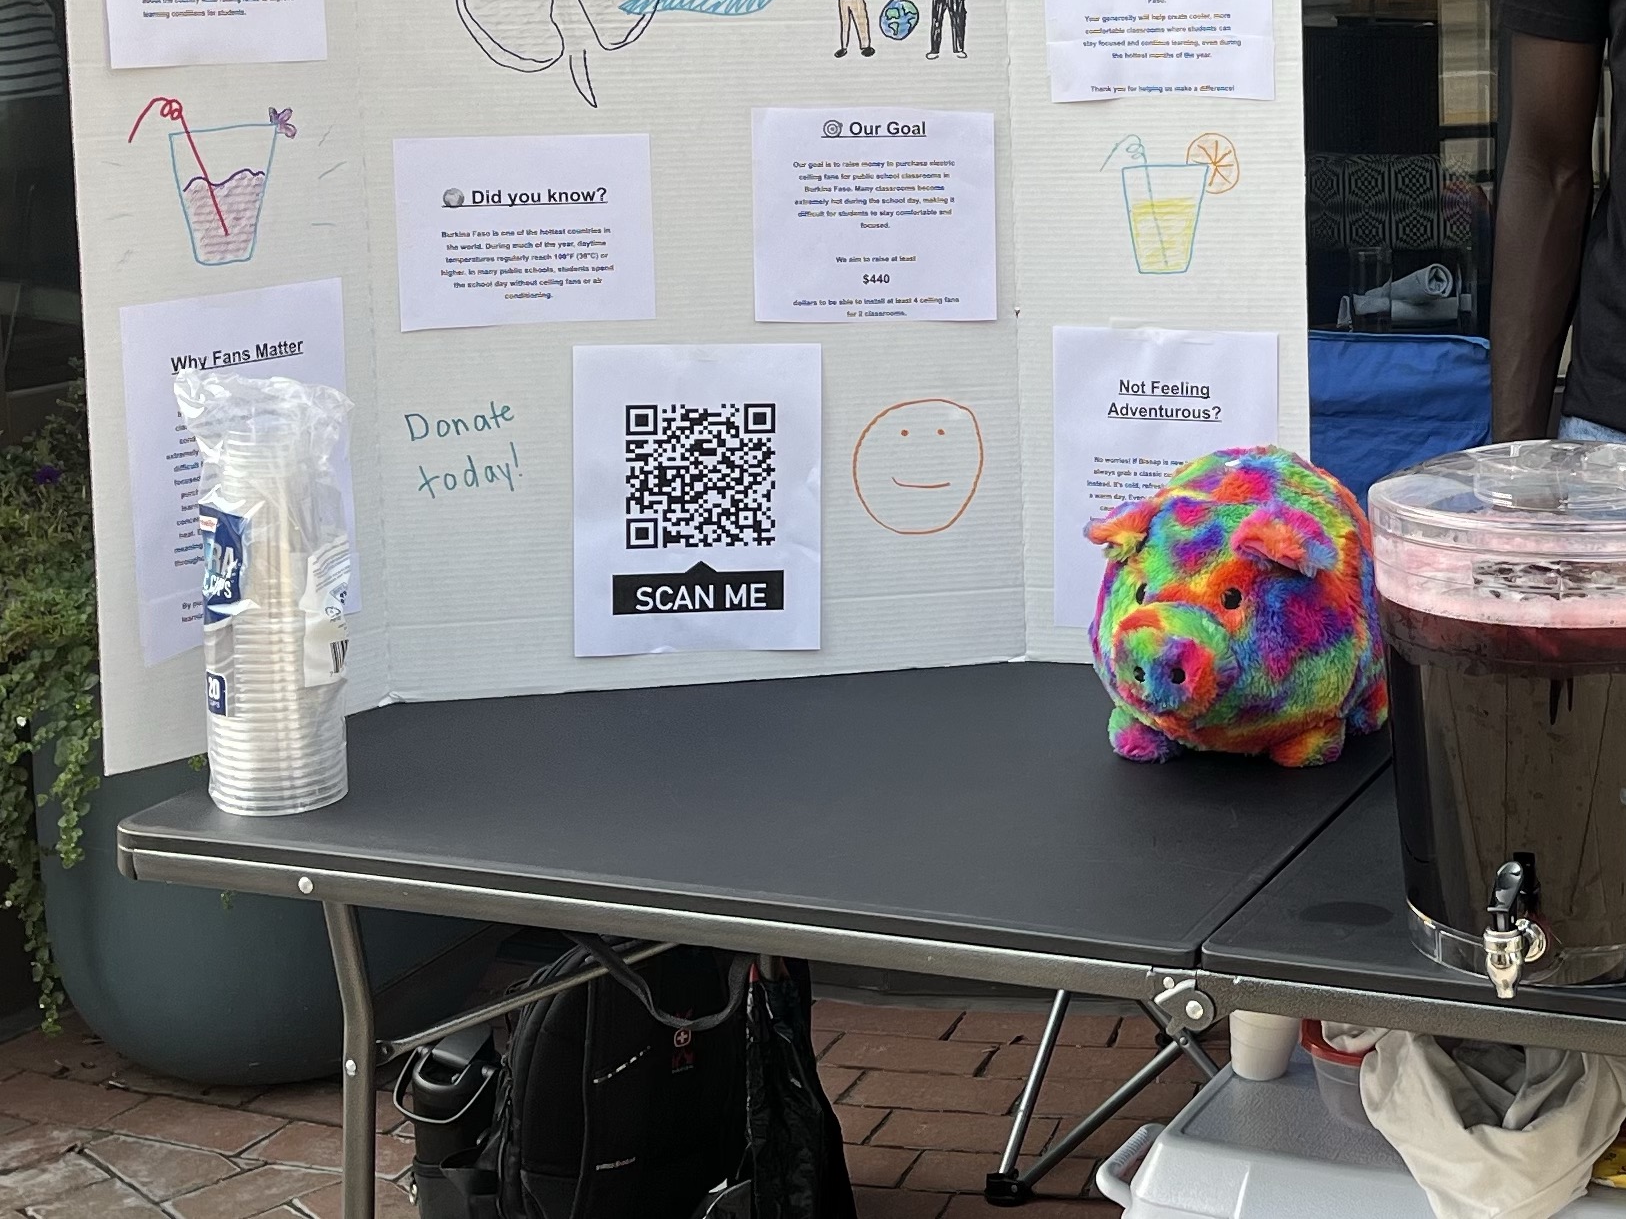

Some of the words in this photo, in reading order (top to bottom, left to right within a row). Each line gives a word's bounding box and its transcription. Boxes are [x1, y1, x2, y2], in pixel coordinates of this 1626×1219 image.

[849, 121, 882, 136] Our
[886, 121, 926, 136] Goal
[472, 189, 502, 204] Did
[508, 192, 541, 207] you
[547, 187, 607, 203] know?
[863, 274, 890, 284] $440
[171, 355, 208, 373] Why
[213, 349, 251, 366] Fans
[255, 340, 303, 359] Matter
[1119, 379, 1146, 395] Not
[1151, 380, 1210, 399] Feeling
[405, 400, 515, 442] Donate
[1108, 402, 1222, 420] Adventurous?
[417, 442, 523, 501] today!
[635, 583, 714, 611] SCAN
[725, 583, 767, 608] ME
